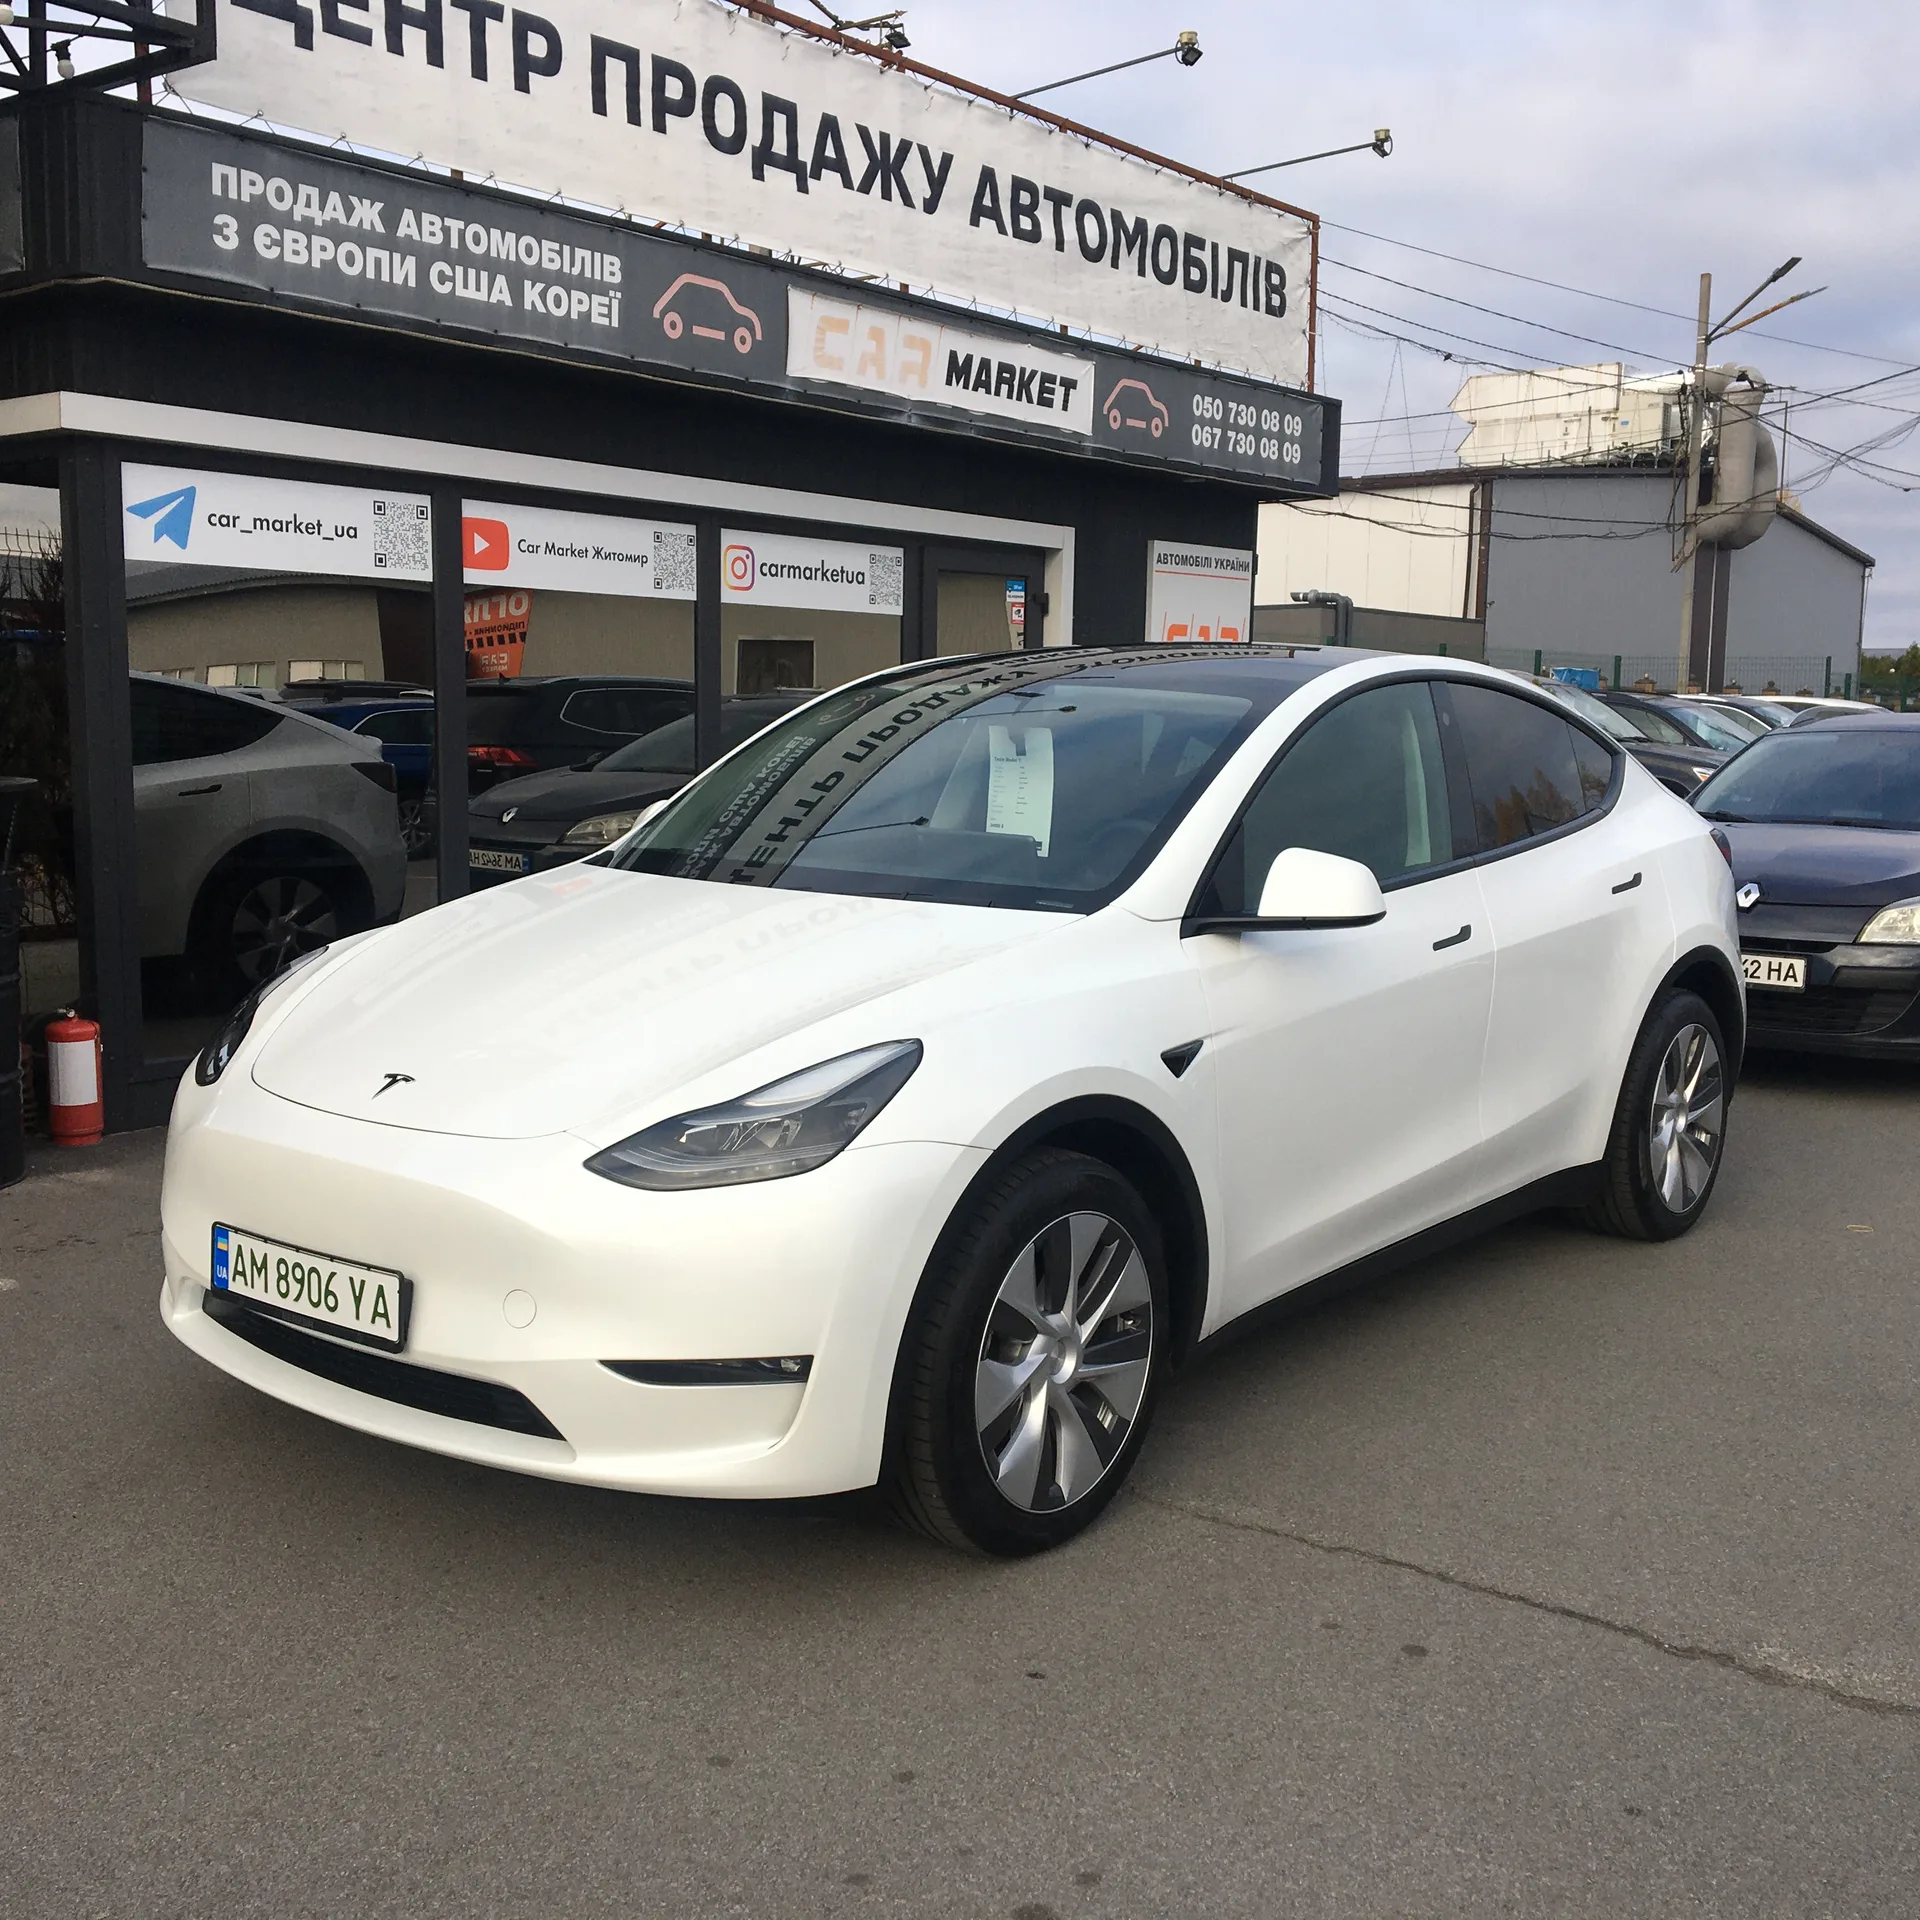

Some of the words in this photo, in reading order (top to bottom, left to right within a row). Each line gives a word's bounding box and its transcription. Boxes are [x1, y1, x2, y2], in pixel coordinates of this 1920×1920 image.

[590, 33, 954, 214] ПРОДАЖУ
[969, 164, 1288, 319] АВТОМОБІЛІВ
[211, 162, 386, 234] ПРОДАЖ
[396, 208, 622, 284] АВТОМОБІЛІВ
[212, 213, 240, 250] З
[253, 223, 416, 288] ЄВРОПИ
[429, 260, 513, 307] США
[523, 279, 622, 328] КОРЕЇ
[945, 349, 1078, 412] MARKET
[1192, 394, 1223, 420] 050
[1228, 401, 1257, 428] 730
[1261, 409, 1280, 432] 08
[1284, 413, 1302, 437] 09
[1192, 423, 1222, 449] 067
[1227, 430, 1256, 456] 730
[1260, 437, 1278, 460] 08
[1283, 442, 1301, 464] 09
[207, 512, 359, 541] car_market_ua
[517, 538, 541, 556] Car
[544, 541, 589, 559] Market
[592, 546, 649, 568] Житомир
[759, 559, 866, 585] carmarketua
[1156, 552, 1212, 569] АВТОМОБІЛІ
[1214, 557, 1250, 573] УКРАЇНИ
[1767, 961, 1798, 982] HA
[216, 1264, 228, 1280] UA
[232, 1244, 269, 1294] AM
[276, 1257, 339, 1313] 8906
[349, 1276, 392, 1329] YA
